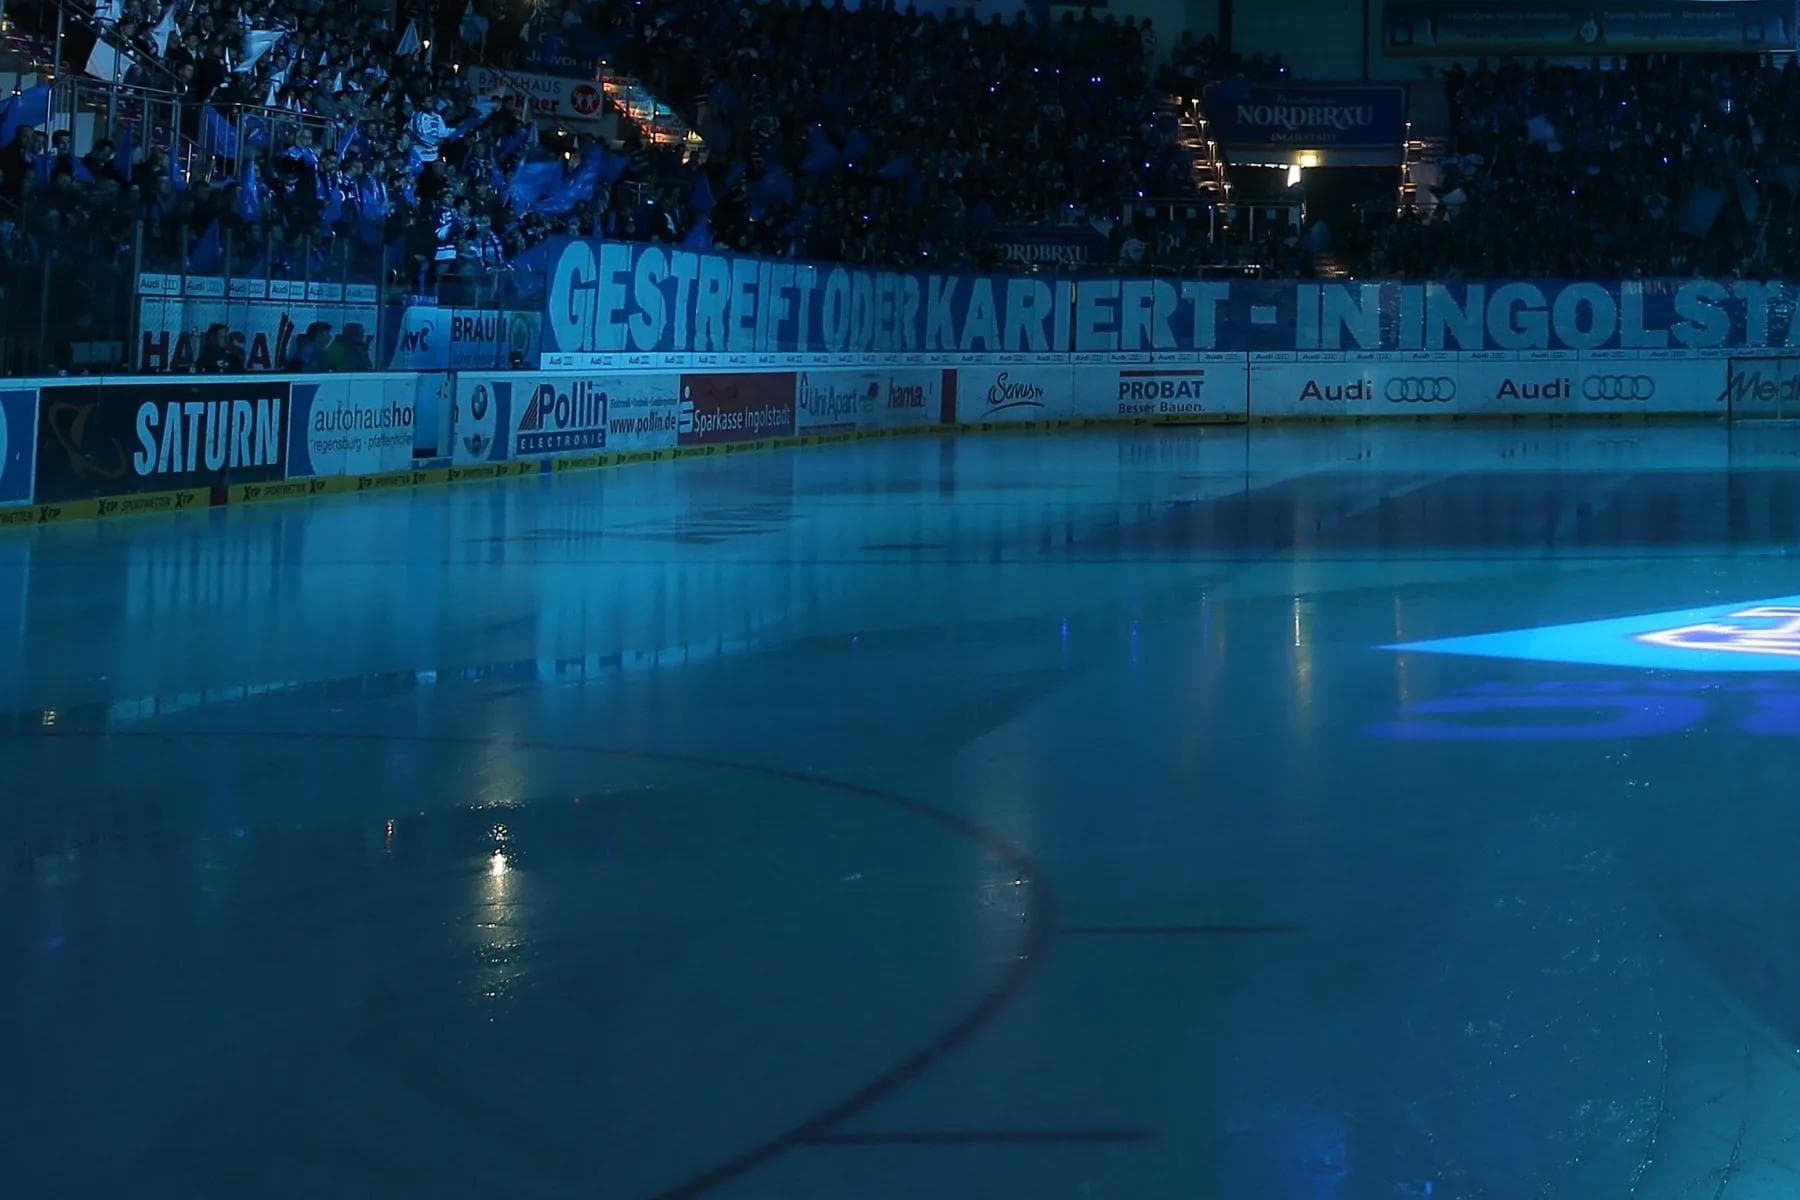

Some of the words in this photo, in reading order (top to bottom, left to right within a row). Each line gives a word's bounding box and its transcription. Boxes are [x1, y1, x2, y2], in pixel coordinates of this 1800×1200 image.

[141, 277, 160, 289] Audi
[549, 240, 817, 353] GESTREIFT
[822, 267, 921, 352] ODER
[925, 275, 1230, 352] KARIERT
[1251, 305, 1277, 325] -
[1295, 281, 1384, 352] IN
[1119, 379, 1205, 400] PROBAT
[1300, 377, 1372, 401] Audi
[1496, 377, 1571, 400] Audi
[539, 381, 609, 430] Pollin
[1118, 402, 1156, 414] Besser
[1160, 401, 1206, 414] Bauen.
[609, 411, 676, 437] www.pollin.de
[694, 410, 743, 437] Sparkasse
[744, 404, 791, 434] Ingolstadt
[133, 398, 281, 477] SATURN
[521, 432, 604, 450] ELECTRONIC
